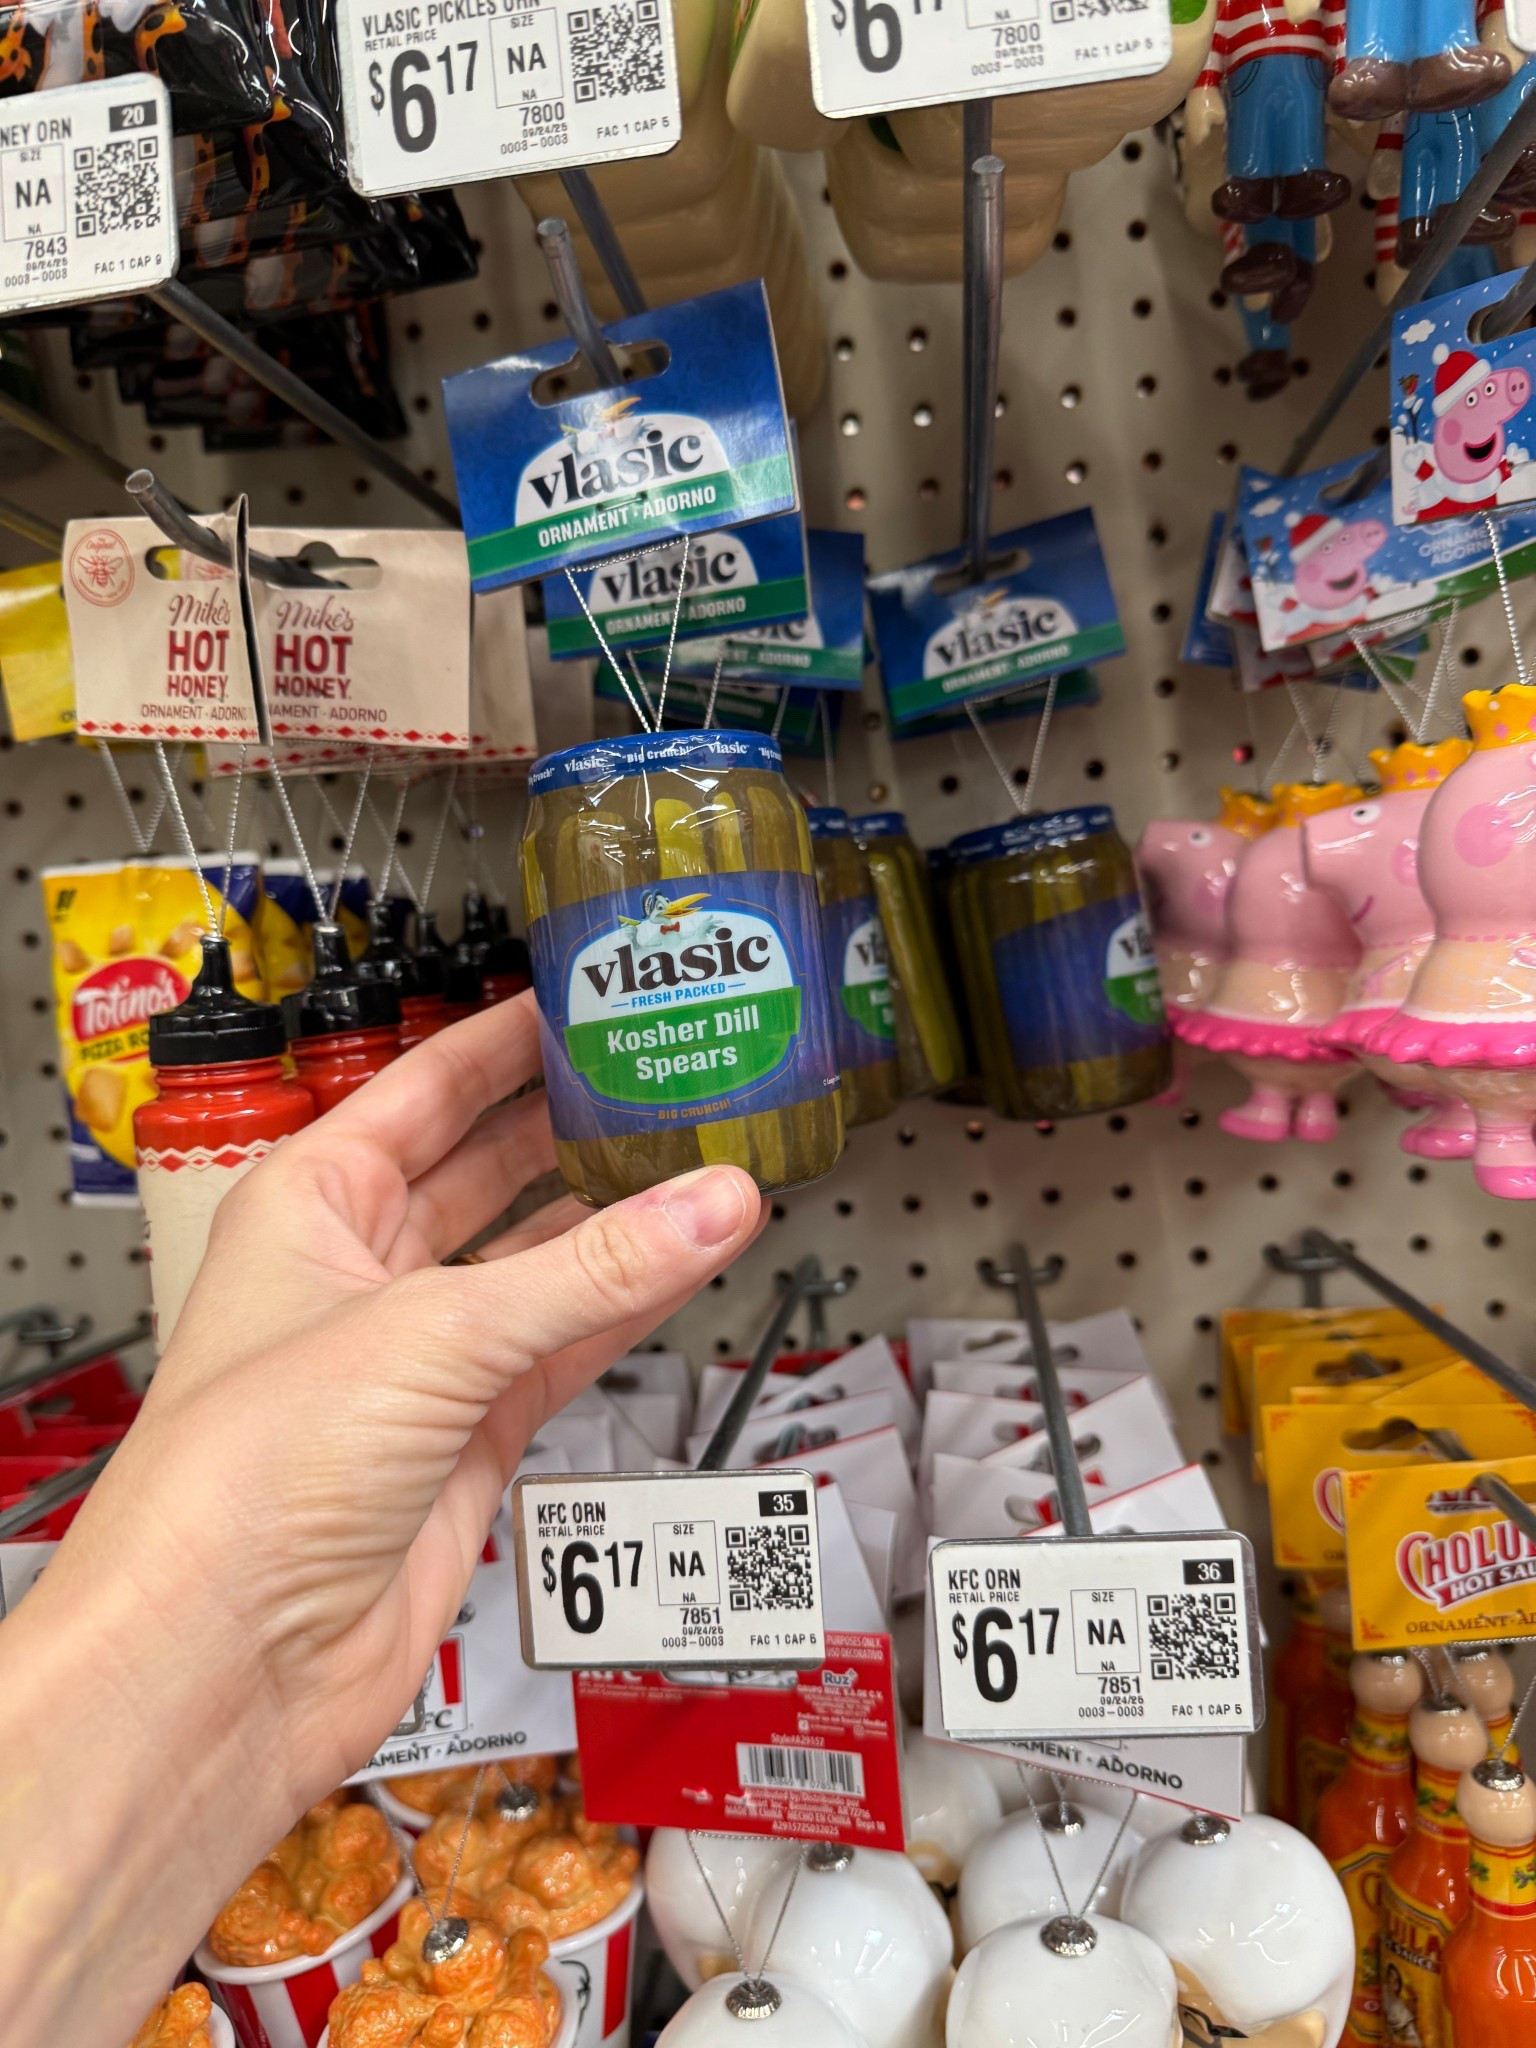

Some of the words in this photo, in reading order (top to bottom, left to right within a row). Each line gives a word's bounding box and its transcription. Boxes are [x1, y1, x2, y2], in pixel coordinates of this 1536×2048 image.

[362, 7, 421, 37] VLASIC
[428, 0, 496, 25] PICKLES
[510, 15, 534, 29] SIZE
[365, 34, 402, 52] RETAIL
[406, 29, 437, 45] PRICE
[991, 24, 1041, 46] 7800
[507, 43, 547, 75] NA
[1075, 47, 1099, 61] FAC
[1105, 47, 1111, 56] 1
[1115, 41, 1140, 54] CAP
[522, 89, 536, 101] NA
[122, 105, 145, 127] 20
[519, 102, 565, 127] 7800
[37, 117, 72, 142] ORN
[522, 123, 567, 138] 09/24/25
[597, 125, 619, 139] FAC
[624, 124, 630, 135] 1
[634, 119, 657, 133] CAP
[662, 117, 669, 128] 5
[20, 149, 42, 161] SIZE
[16, 178, 51, 209] NA
[28, 224, 42, 235] NA
[25, 237, 68, 260] 7843
[94, 261, 115, 274] FAC
[120, 260, 125, 270] 1
[129, 255, 150, 268] CAP
[528, 430, 704, 509] vlasic
[538, 507, 629, 548] ORNAMENT
[643, 486, 716, 520] ADORNO
[601, 545, 738, 603] vlasic
[169, 587, 231, 627] Mike's
[276, 595, 355, 631] Mike's
[688, 596, 746, 621] ADORNO
[933, 610, 1056, 667] vlasic
[168, 630, 229, 672] HOT
[274, 634, 352, 674] HOT
[142, 704, 203, 721] ORNAMENT
[330, 708, 387, 723] ADORNO
[708, 741, 748, 754] vlasic
[564, 755, 605, 773] vlasic
[581, 926, 771, 999] vlasic
[75, 972, 178, 1033] Totino's
[631, 991, 671, 1008] FRESH
[674, 982, 726, 1002] PACKED
[606, 1018, 705, 1055] Kosher
[714, 1004, 760, 1038] Dill
[80, 1036, 126, 1061] PIZZA
[636, 1044, 738, 1084] Spears
[657, 1107, 678, 1121] BIG
[681, 1099, 732, 1119] CRUNCH!
[537, 1502, 567, 1525] KFC
[573, 1501, 606, 1522] ORN
[773, 1494, 794, 1513] 35
[538, 1525, 574, 1538] RETAIL
[577, 1524, 605, 1537] PRICE
[673, 1524, 695, 1535] SIZE
[669, 1550, 706, 1577] NA
[1198, 1562, 1222, 1582] 36
[948, 1569, 979, 1591] KFC
[986, 1569, 1021, 1589] ORN
[1450, 1572, 1495, 1599] HOT
[683, 1593, 696, 1603] NA
[949, 1592, 987, 1604] RETAIL
[990, 1590, 1020, 1603] PRICE
[1091, 1591, 1114, 1603] SIZE
[680, 1607, 721, 1625] 7851
[1406, 1614, 1508, 1634] ORNAMENT
[750, 1635, 770, 1646] FAC
[775, 1634, 780, 1645] 1
[784, 1634, 805, 1645] CAP
[1087, 1619, 1125, 1646] NA
[1101, 1661, 1115, 1672] NA
[823, 1671, 851, 1685] Ruz
[1098, 1676, 1141, 1694] 7851
[423, 1709, 453, 1729] FC
[1172, 1704, 1192, 1717] FAC
[1199, 1704, 1203, 1716] 1
[1209, 1704, 1231, 1715] CAP
[1235, 1703, 1242, 1715] 5
[364, 1744, 430, 1769] AMENT
[448, 1730, 527, 1756] ADORNO
[1097, 1756, 1183, 1789] ADORNO
